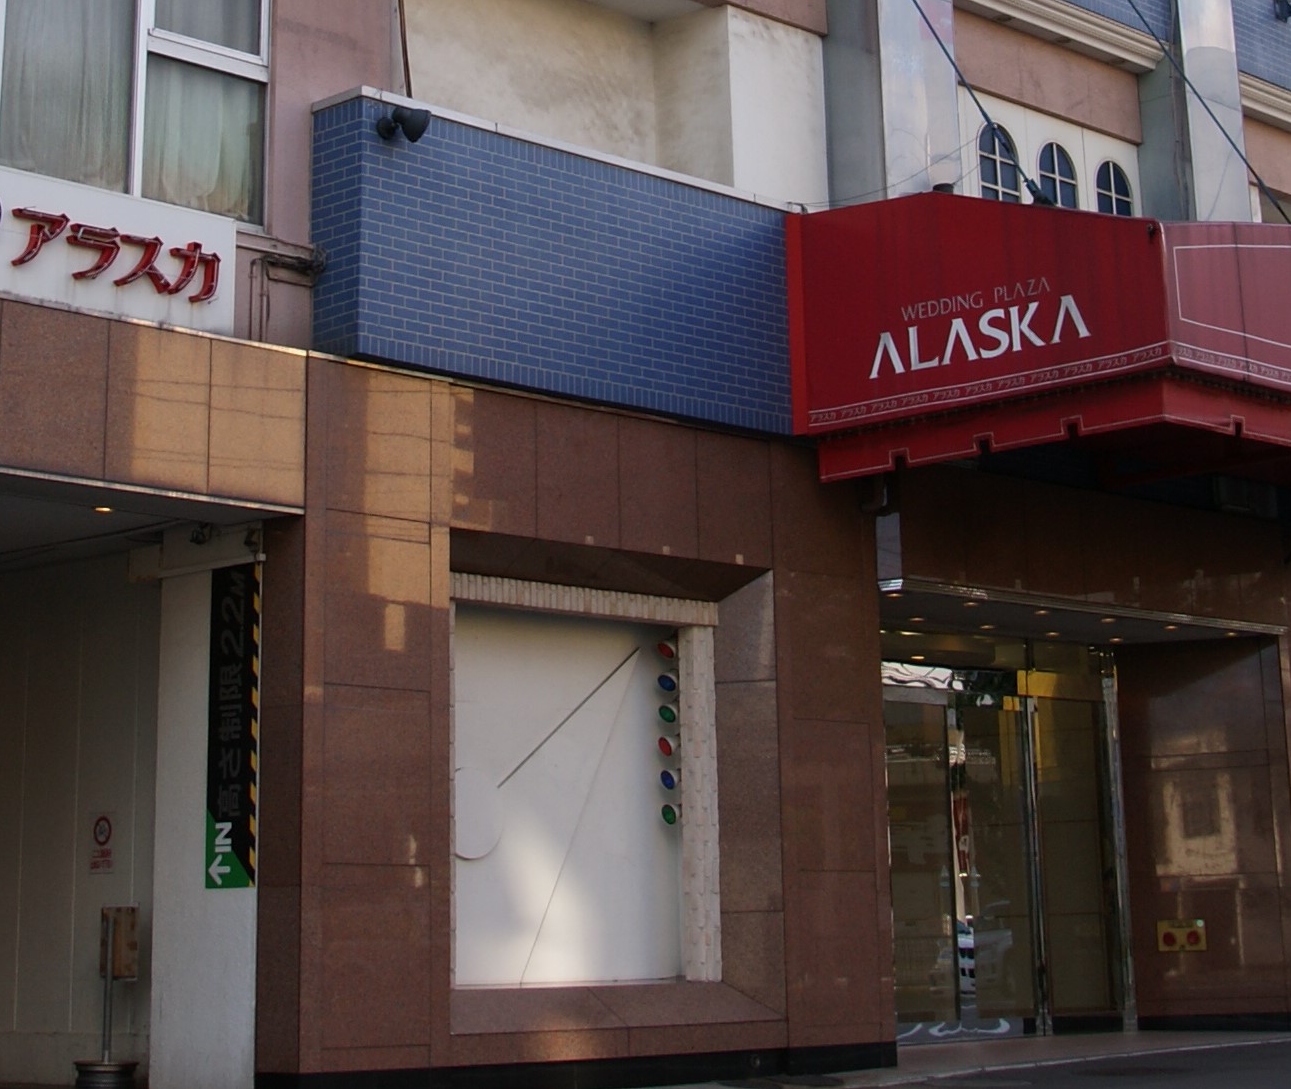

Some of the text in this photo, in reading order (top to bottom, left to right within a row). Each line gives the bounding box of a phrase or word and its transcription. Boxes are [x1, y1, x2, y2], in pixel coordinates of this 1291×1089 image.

[11, 208, 221, 303] アラスカ
[901, 276, 1051, 321] WEDDING PLAZA
[868, 294, 1092, 380] ALASKA
[215, 822, 232, 853] IN
